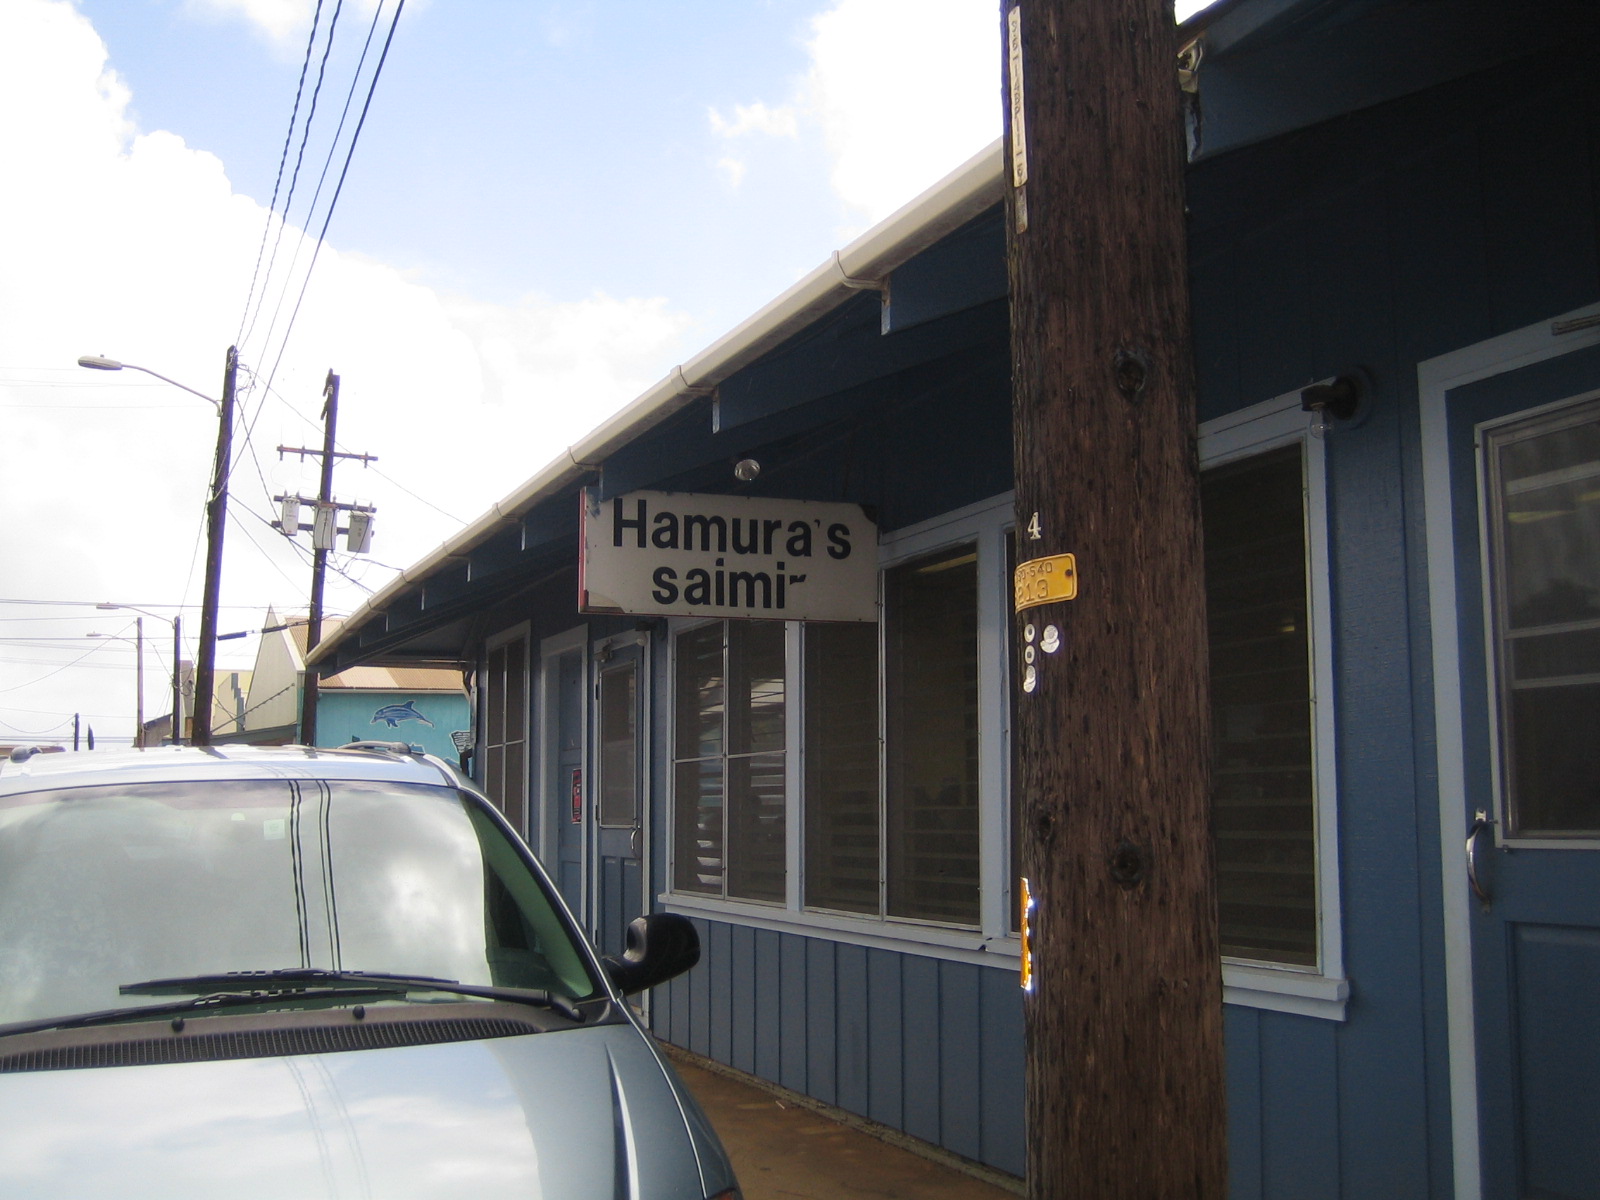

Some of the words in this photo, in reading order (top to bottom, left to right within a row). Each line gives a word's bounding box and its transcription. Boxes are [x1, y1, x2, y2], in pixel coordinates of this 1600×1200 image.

[613, 497, 852, 560] Hamura's
[1027, 511, 1042, 540] 4
[652, 557, 807, 609] saimi
